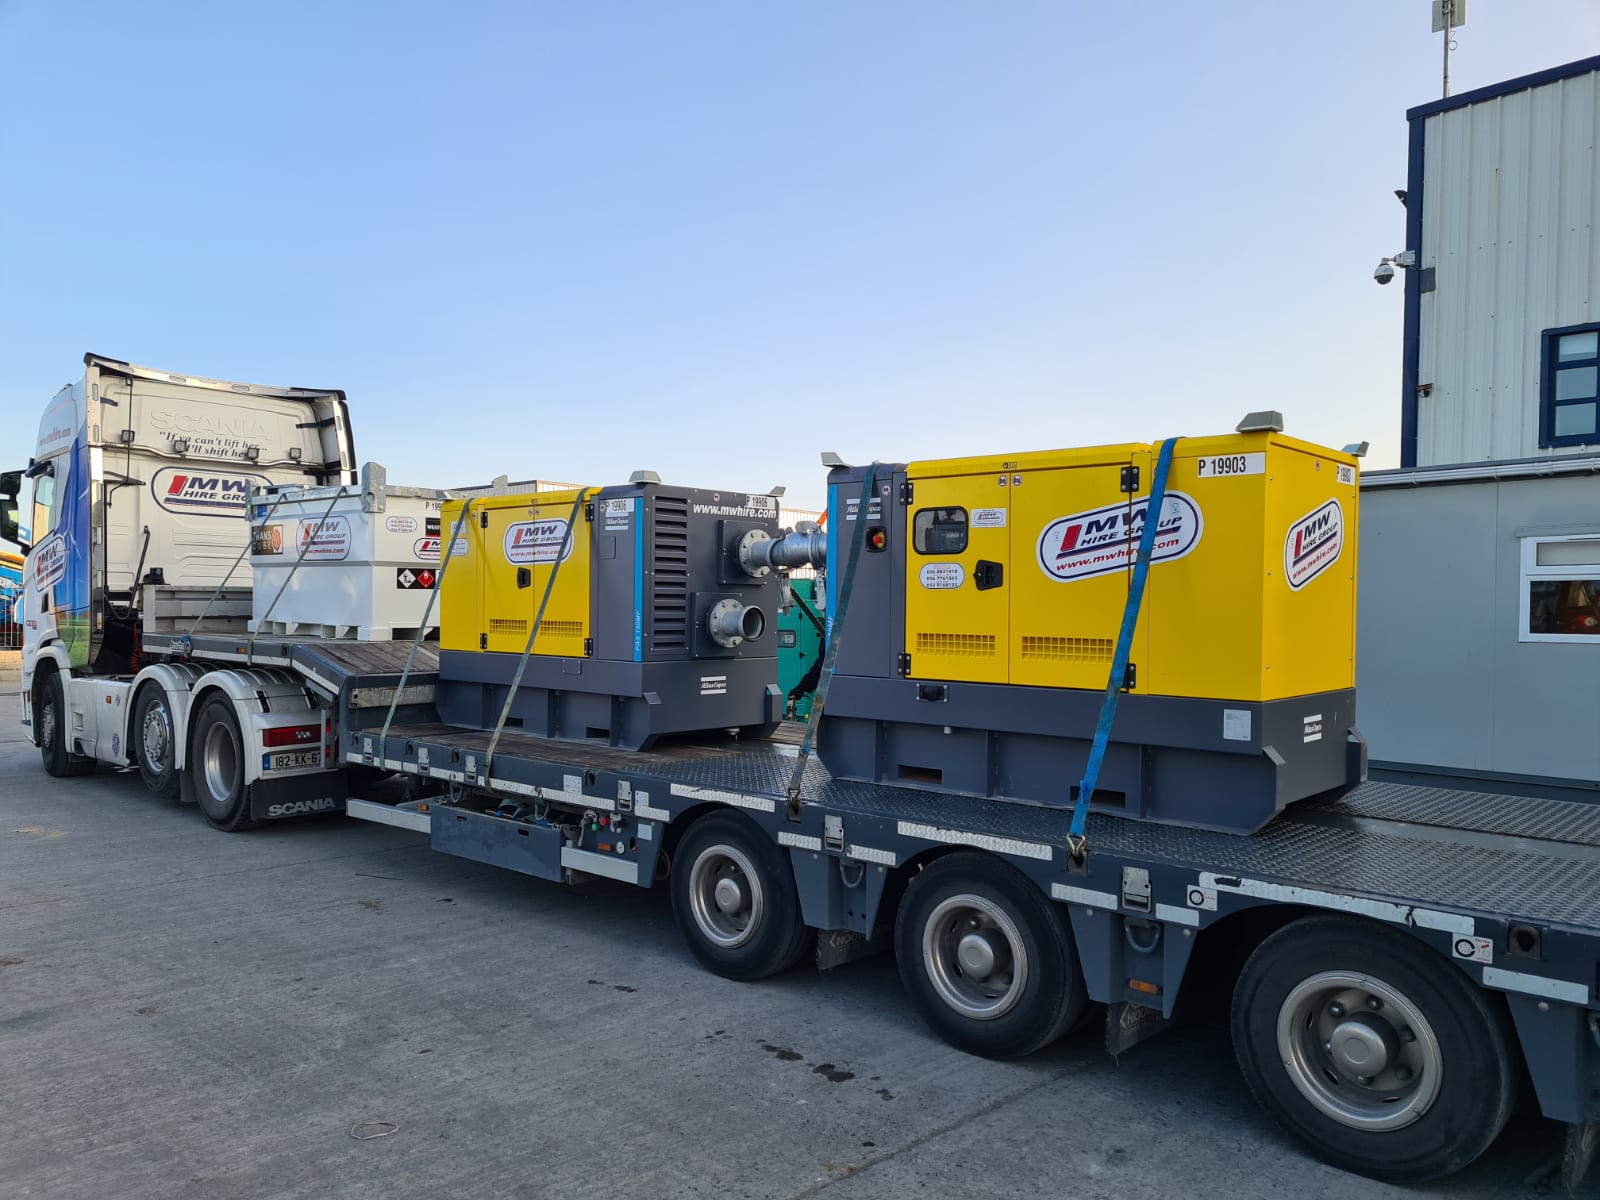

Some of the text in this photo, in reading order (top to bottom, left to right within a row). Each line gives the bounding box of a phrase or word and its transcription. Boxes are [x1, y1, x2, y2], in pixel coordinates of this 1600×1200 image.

[150, 410, 273, 441] SCANIA
[195, 437, 221, 447] can't
[225, 439, 240, 449] lift
[205, 446, 229, 457] shift
[1198, 456, 1246, 476] P 19903
[187, 476, 247, 492] MW
[183, 489, 247, 502] HIRE GRO
[425, 501, 430, 510] P
[746, 496, 752, 506] P
[693, 503, 777, 519] www.mwhire.com
[312, 521, 340, 533] MW
[524, 525, 558, 537] MW
[1080, 516, 1183, 547] HIRE GRUP
[1084, 508, 1149, 536] MW
[1303, 510, 1331, 541] MW
[1302, 522, 1338, 552] HIRE GROUP
[41, 543, 58, 564] MW
[1056, 538, 1180, 572] www.mwhircom
[1292, 542, 1338, 579] www.mwhire.com
[268, 797, 337, 817] SCANIA
